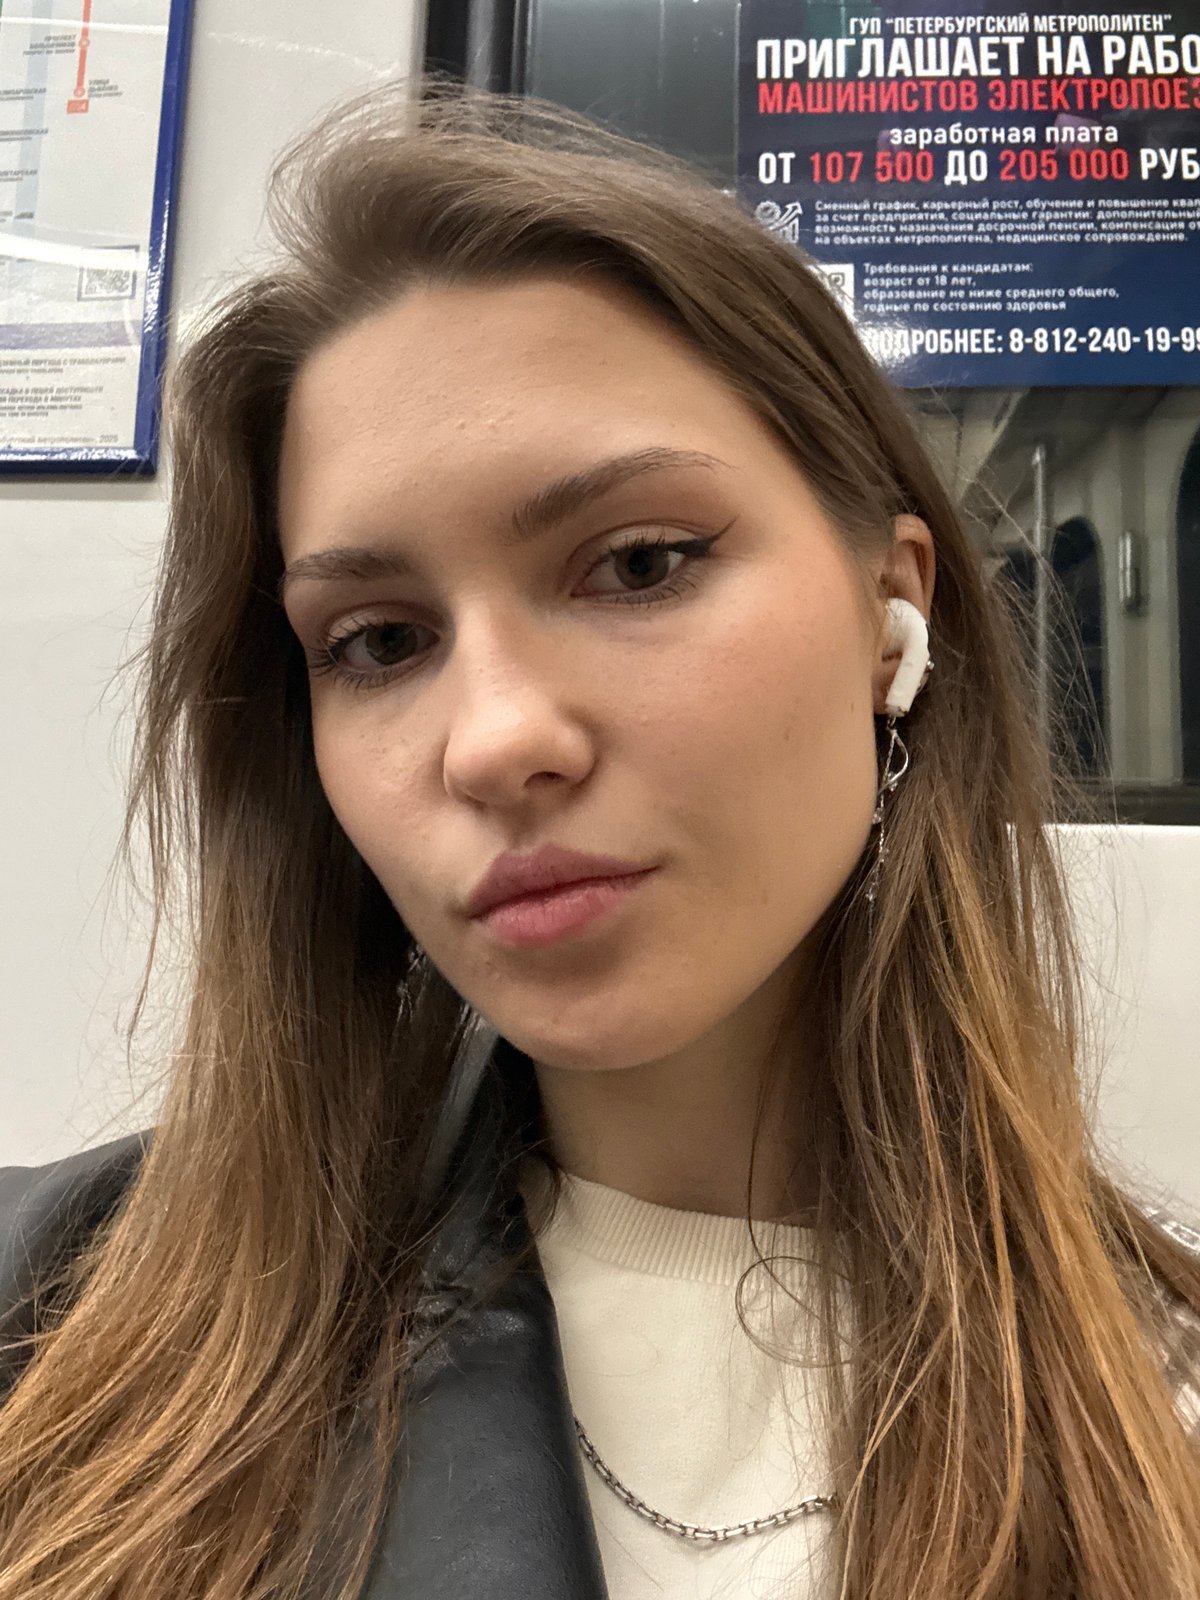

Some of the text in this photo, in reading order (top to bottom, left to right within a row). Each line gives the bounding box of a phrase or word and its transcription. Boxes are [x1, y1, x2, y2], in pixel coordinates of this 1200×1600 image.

[849, 17, 881, 34] ГУП
[757, 34, 1200, 79] ПРИГЛАШАЕТ НА РАБО
[758, 79, 977, 113] МАШИНИСТОВ
[889, 123, 1117, 148] заработная плата
[758, 152, 795, 184] ОТ
[811, 151, 862, 183] 107
[875, 150, 933, 182] 500
[944, 149, 987, 185] ДО
[999, 149, 1057, 181] 205
[1069, 148, 1128, 180] 000
[815, 199, 870, 211] Сменный
[922, 199, 989, 211] карьерный
[992, 199, 1022, 210] рост,
[1025, 198, 1083, 210] обучение
[1086, 199, 1094, 208] и
[1098, 198, 1169, 211] повышение
[815, 213, 829, 222] за
[832, 213, 859, 222] счет
[863, 212, 948, 223] предприятия,
[951, 211, 1028, 222] социальные
[814, 223, 896, 234] возможность
[899, 223, 973, 232] назначения
[977, 222, 1045, 233] досрочной
[1048, 221, 1097, 231] пенсии,
[1101, 221, 1184, 231] компенсация
[814, 235, 830, 244] на
[833, 234, 890, 244] объектах
[894, 234, 992, 245] метрополитена,
[996, 233, 1080, 243] медицинское
[864, 263, 937, 275] Требования
[941, 264, 948, 273] к
[863, 275, 975, 288] возраст от 18 лет,
[863, 286, 1119, 301] образование не ниже среднего общего,
[863, 301, 1066, 312] годные по состоянию здоровья
